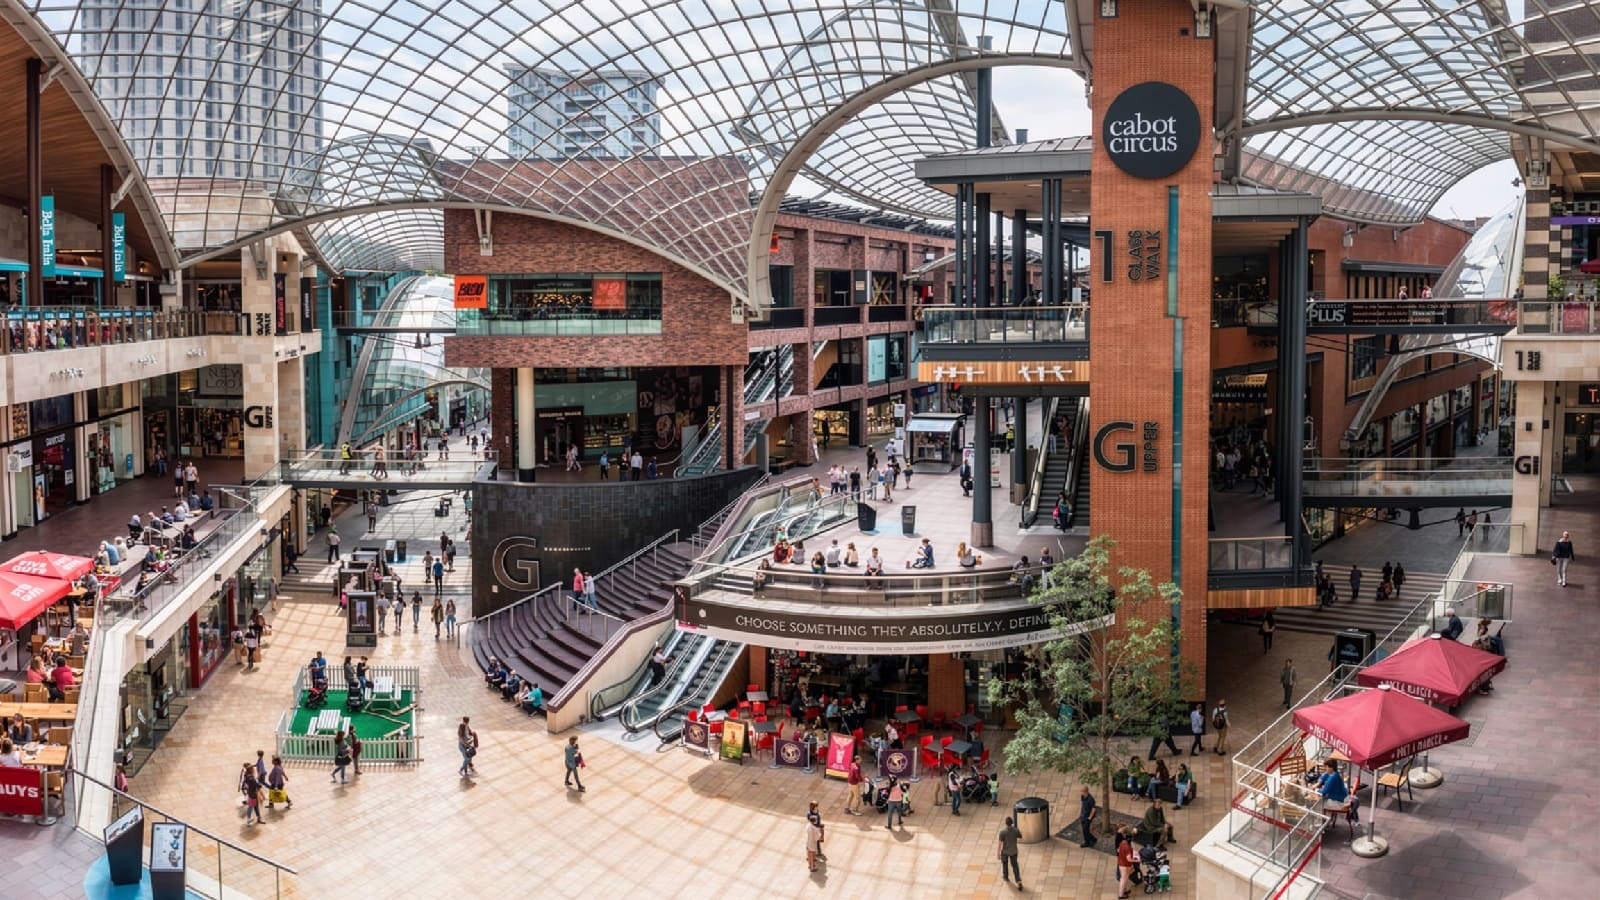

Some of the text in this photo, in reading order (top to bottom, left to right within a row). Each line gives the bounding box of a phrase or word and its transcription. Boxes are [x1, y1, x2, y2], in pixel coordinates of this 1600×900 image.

[1109, 112, 1176, 136] cabot
[1109, 135, 1178, 153] circus
[1094, 230, 1113, 282] 1
[1127, 229, 1142, 281] GLASS
[1145, 229, 1161, 281] WALK
[1310, 306, 1345, 322] PLUS
[244, 405, 264, 429] G
[1093, 421, 1137, 473] G
[1143, 421, 1160, 473] UPPER
[1515, 455, 1532, 475] G
[493, 535, 540, 592] G
[735, 614, 787, 632] CHOOSE
[789, 621, 867, 637] SOMETHING
[871, 625, 908, 637] THEY
